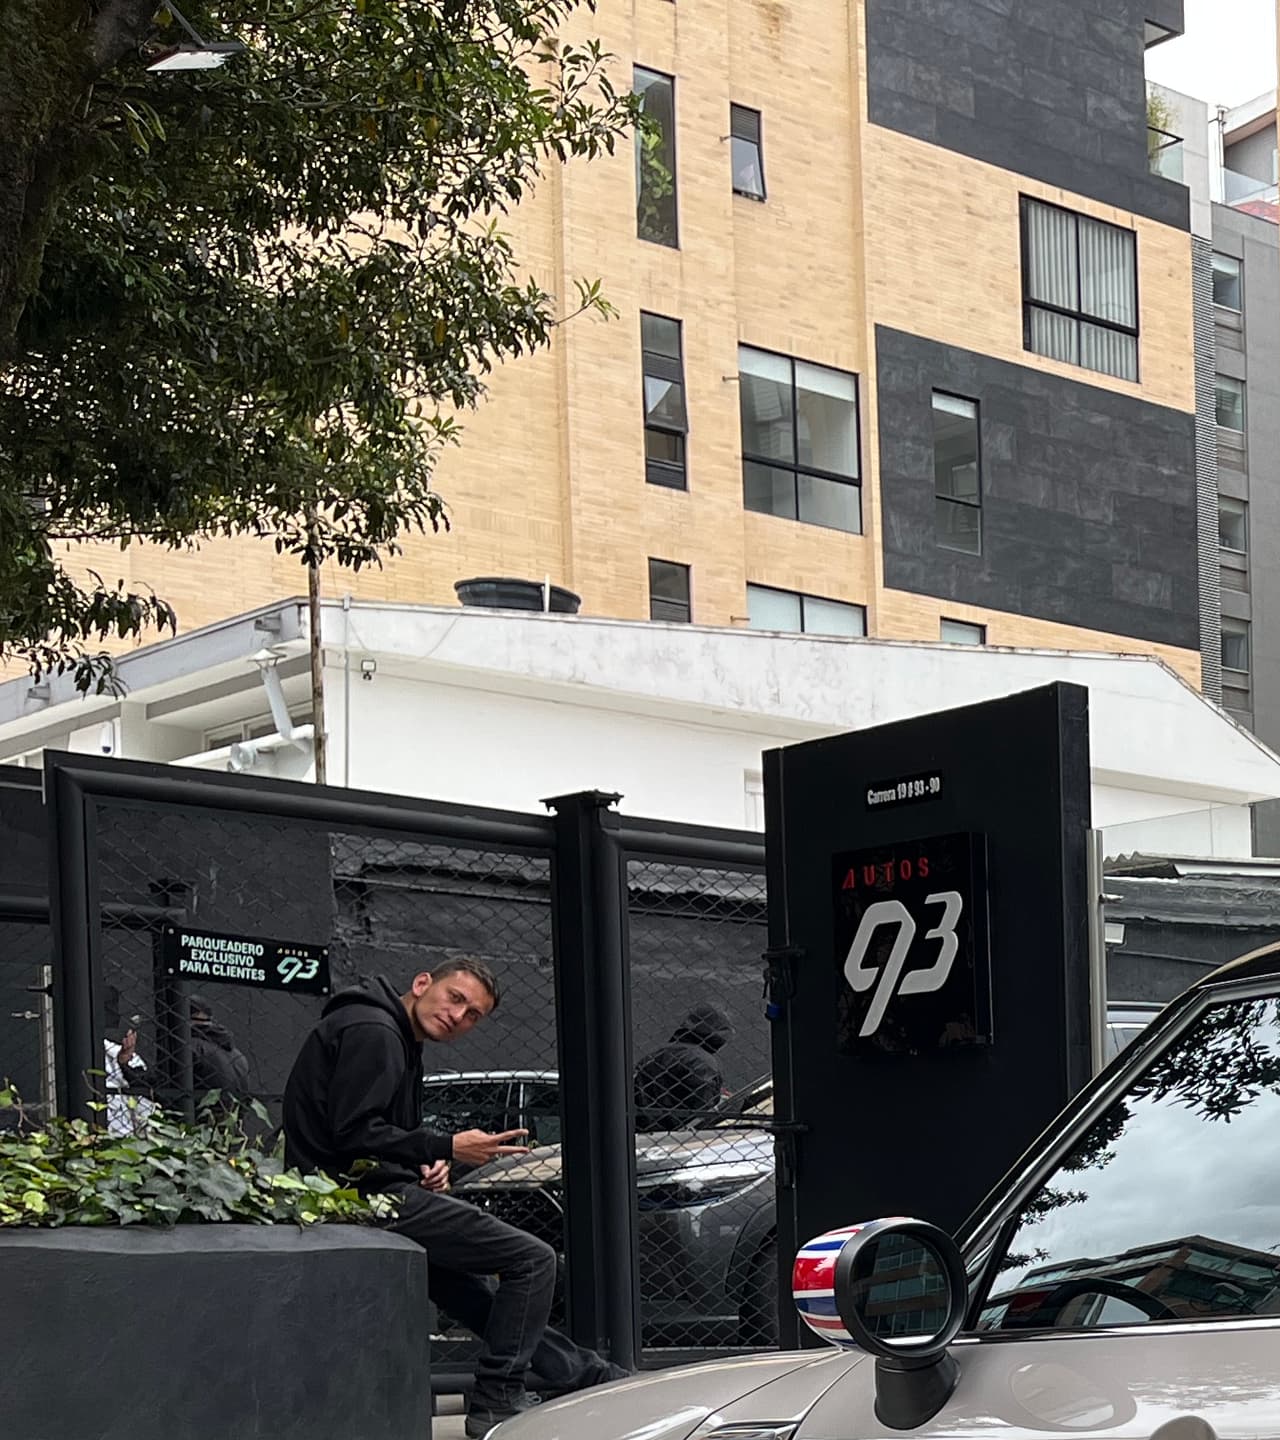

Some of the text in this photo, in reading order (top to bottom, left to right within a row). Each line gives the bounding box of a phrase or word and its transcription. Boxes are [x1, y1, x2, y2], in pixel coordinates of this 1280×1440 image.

[842, 857, 930, 889] AUTOS
[181, 934, 265, 957] PARQUEADERO
[191, 949, 255, 967] EXCLUSIVO
[179, 959, 266, 982] PARA CLIENTES
[276, 956, 320, 984] 93
[844, 890, 963, 1037] 93
